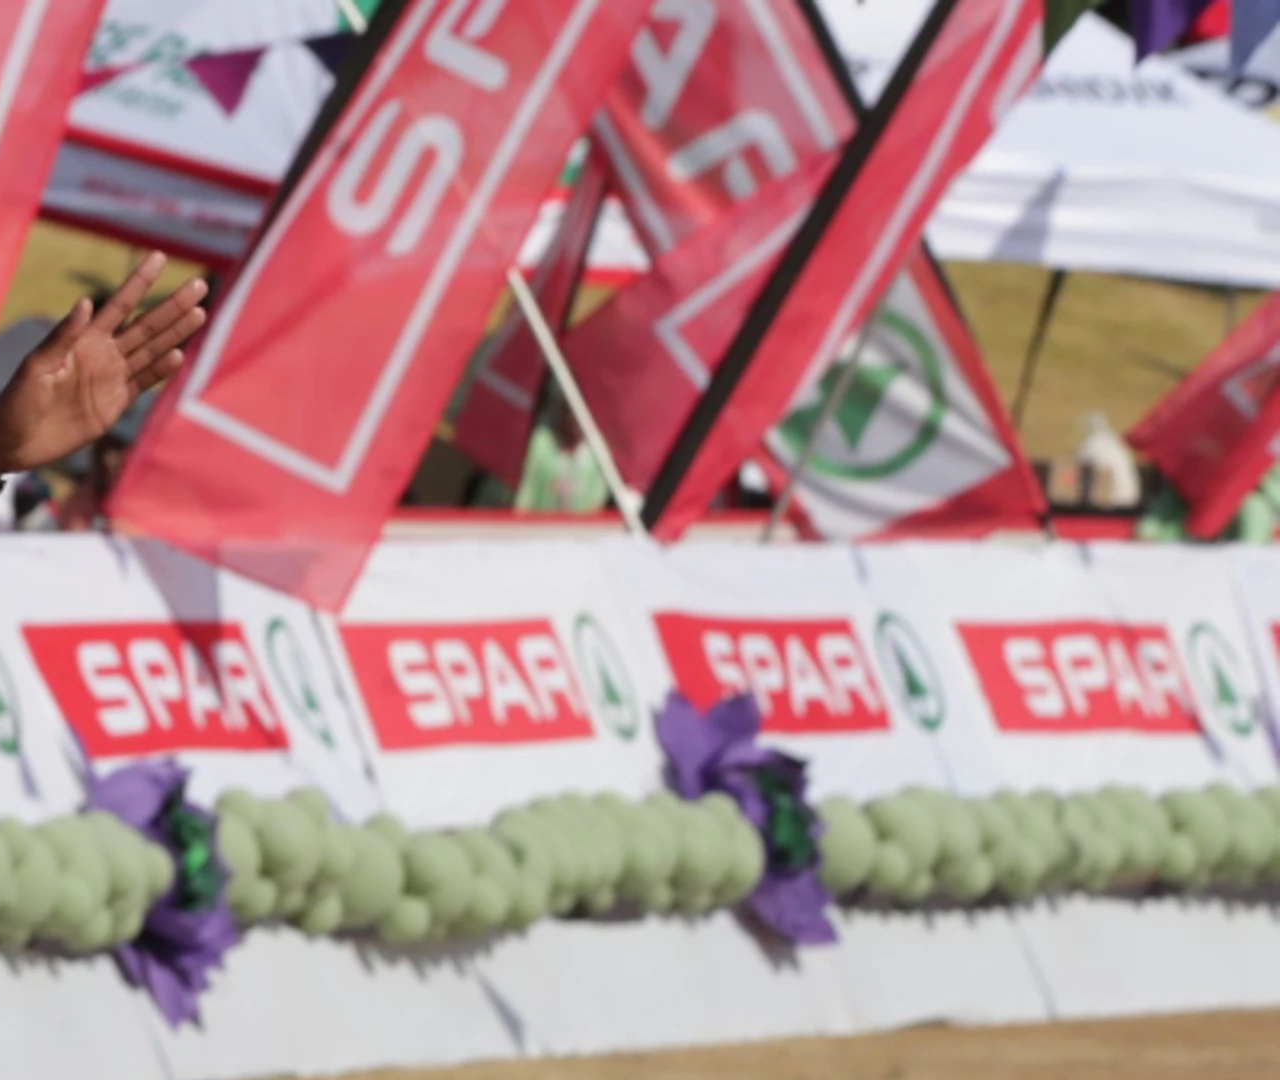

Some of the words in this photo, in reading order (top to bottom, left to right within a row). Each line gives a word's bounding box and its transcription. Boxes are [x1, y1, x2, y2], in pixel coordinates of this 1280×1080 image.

[75, 637, 279, 738] SPAR
[386, 632, 590, 730] SPAR
[700, 629, 884, 719] SPAR
[1001, 632, 1195, 720] SPAR
